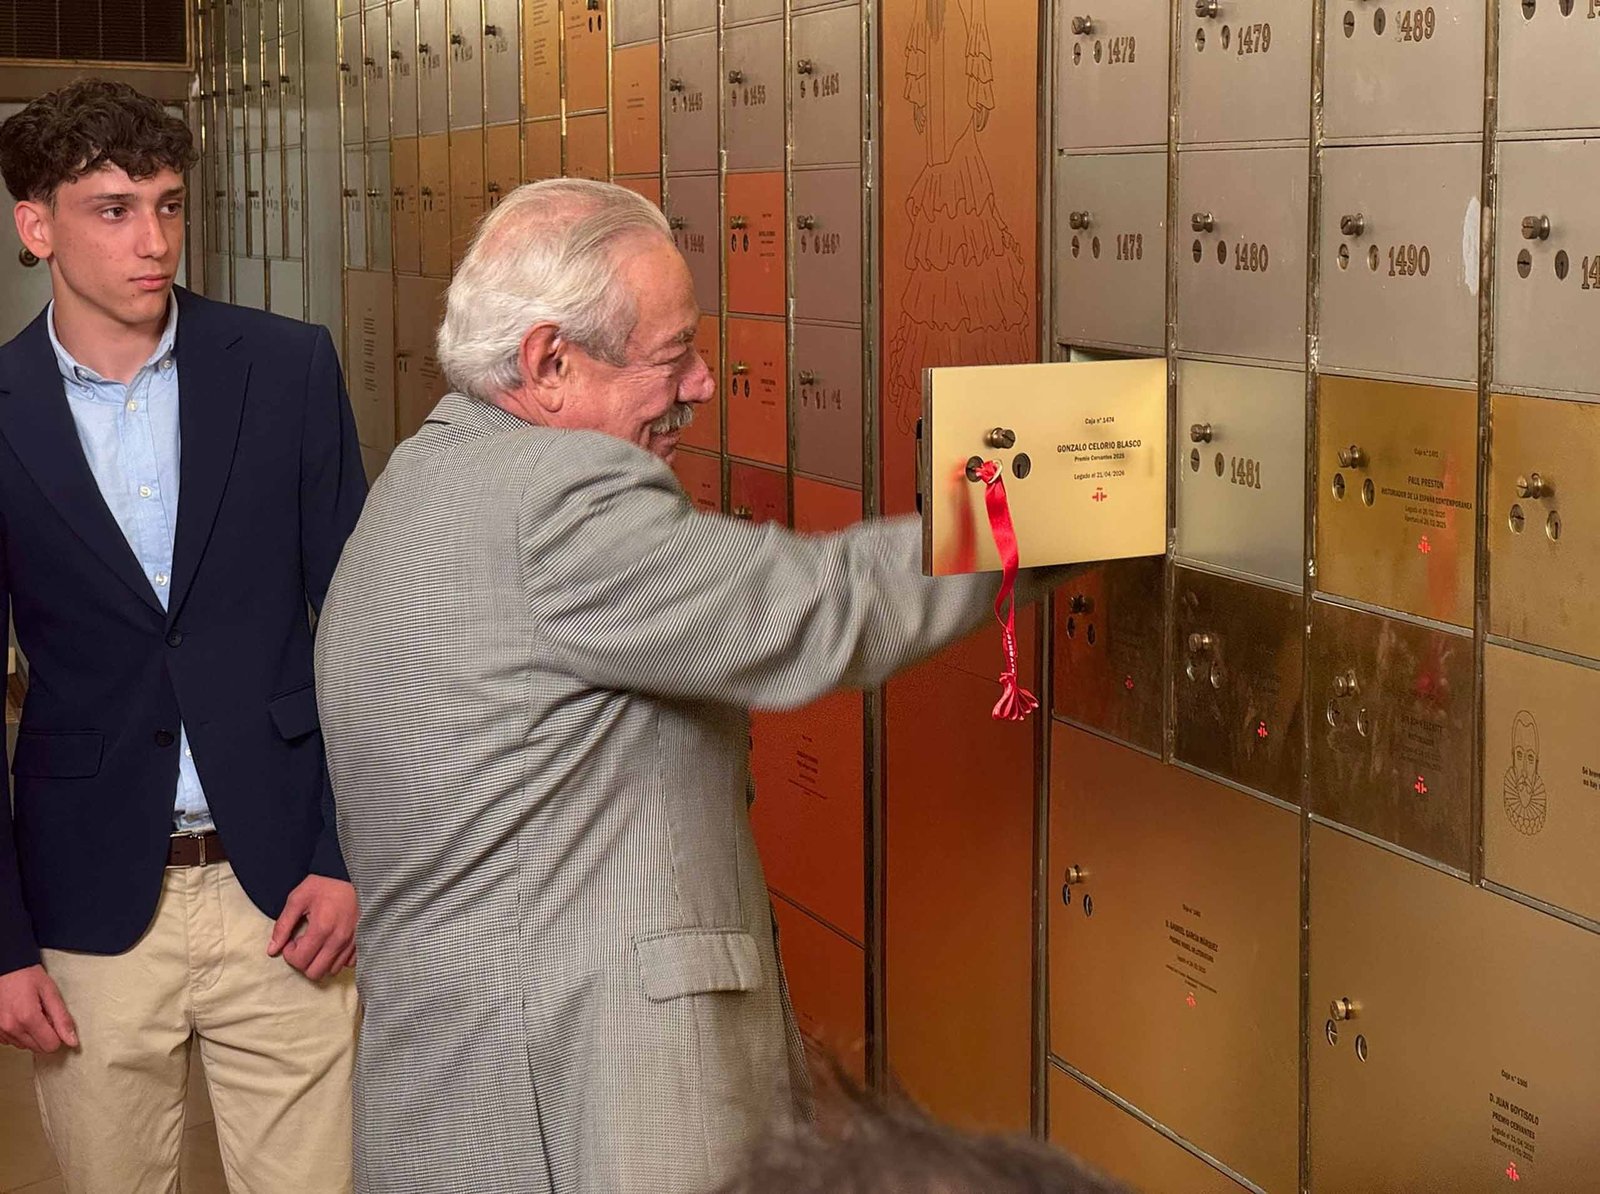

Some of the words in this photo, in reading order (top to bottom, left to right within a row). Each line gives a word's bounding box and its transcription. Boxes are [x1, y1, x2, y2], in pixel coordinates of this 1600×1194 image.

[1107, 36, 1136, 64] 1472
[1237, 22, 1272, 55] 1479
[1116, 233, 1143, 260] 1473
[1234, 243, 1269, 272] 1480
[1388, 244, 1431, 277] 1490
[1581, 256, 1600, 289] 14
[1057, 443, 1087, 453] GONZALO
[1088, 441, 1115, 451] CELORIO
[1116, 439, 1142, 449] BLASCO
[1231, 456, 1261, 489] 1481
[1421, 478, 1444, 489] PRESTON
[1510, 1103, 1540, 1126] GOYTISOLO
[1510, 1120, 1536, 1140] CERVANTES
